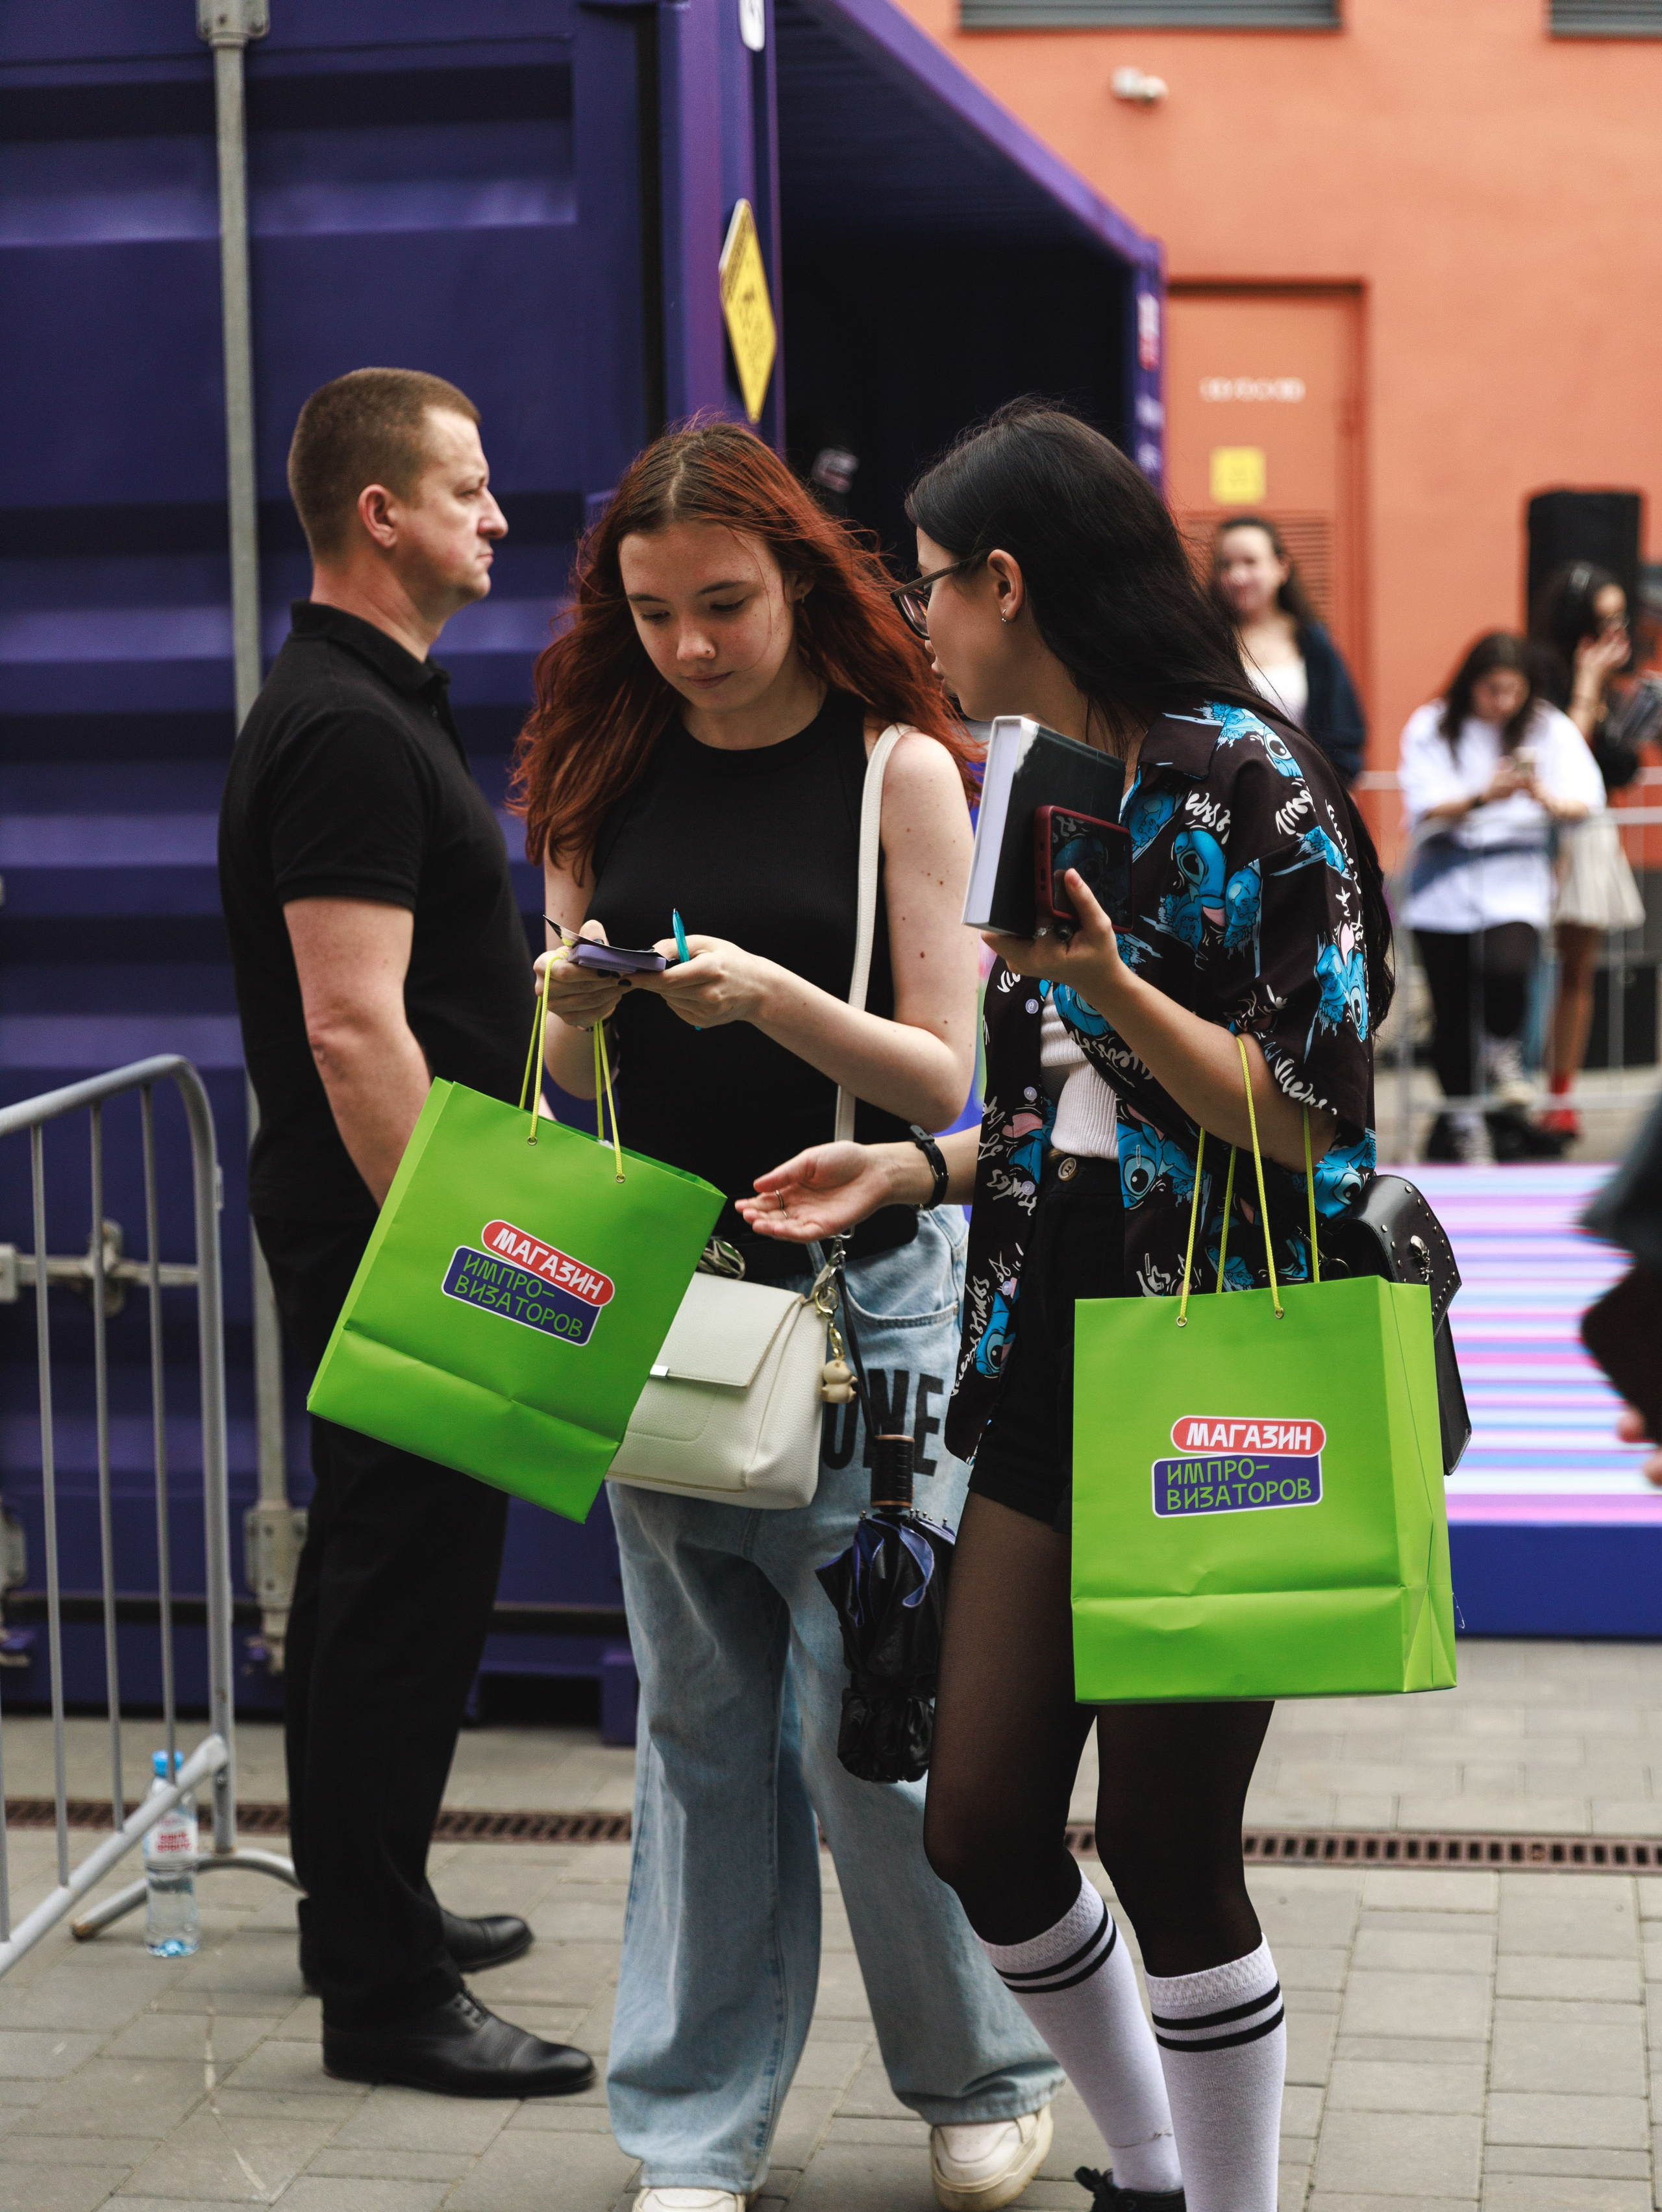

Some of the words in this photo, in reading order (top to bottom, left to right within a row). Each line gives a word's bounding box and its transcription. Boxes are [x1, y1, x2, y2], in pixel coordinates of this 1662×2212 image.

[462, 1254, 555, 1298] ИМПРО-
[491, 1228, 604, 1299] МАГАЗИН
[454, 1274, 583, 1337] ВИЗАТОРОВ
[1186, 1423, 1312, 1450] МАГАЗИН
[1167, 1458, 1270, 1485] ИМПРО-
[1167, 1478, 1312, 1511] ВИЗАТОРОВ
